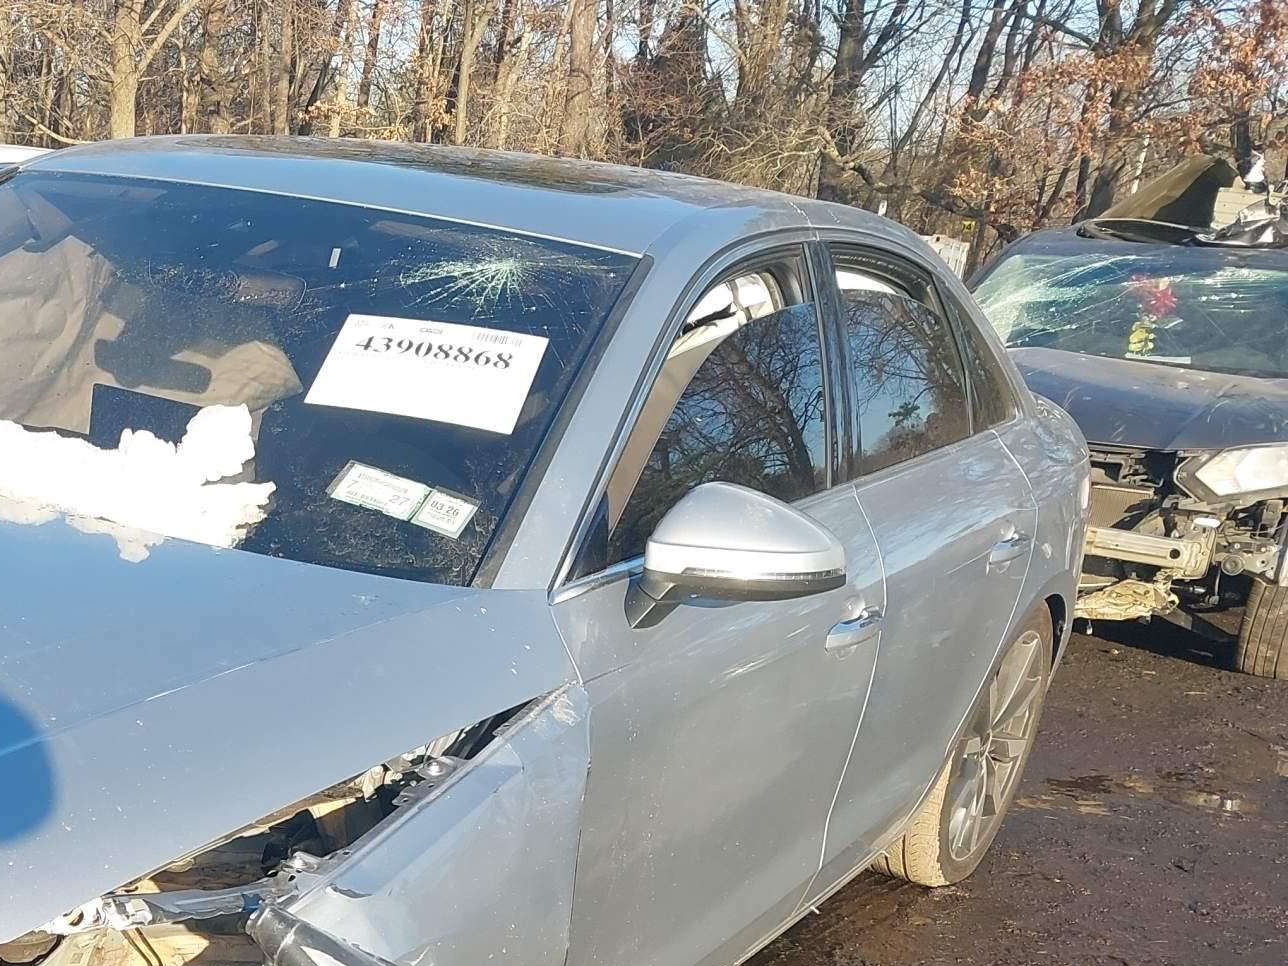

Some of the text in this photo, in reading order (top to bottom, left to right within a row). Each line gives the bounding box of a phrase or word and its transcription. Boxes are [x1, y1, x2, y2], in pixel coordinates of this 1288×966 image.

[355, 335, 514, 370] 43908868
[388, 494, 411, 506] 27
[430, 500, 444, 512] 03
